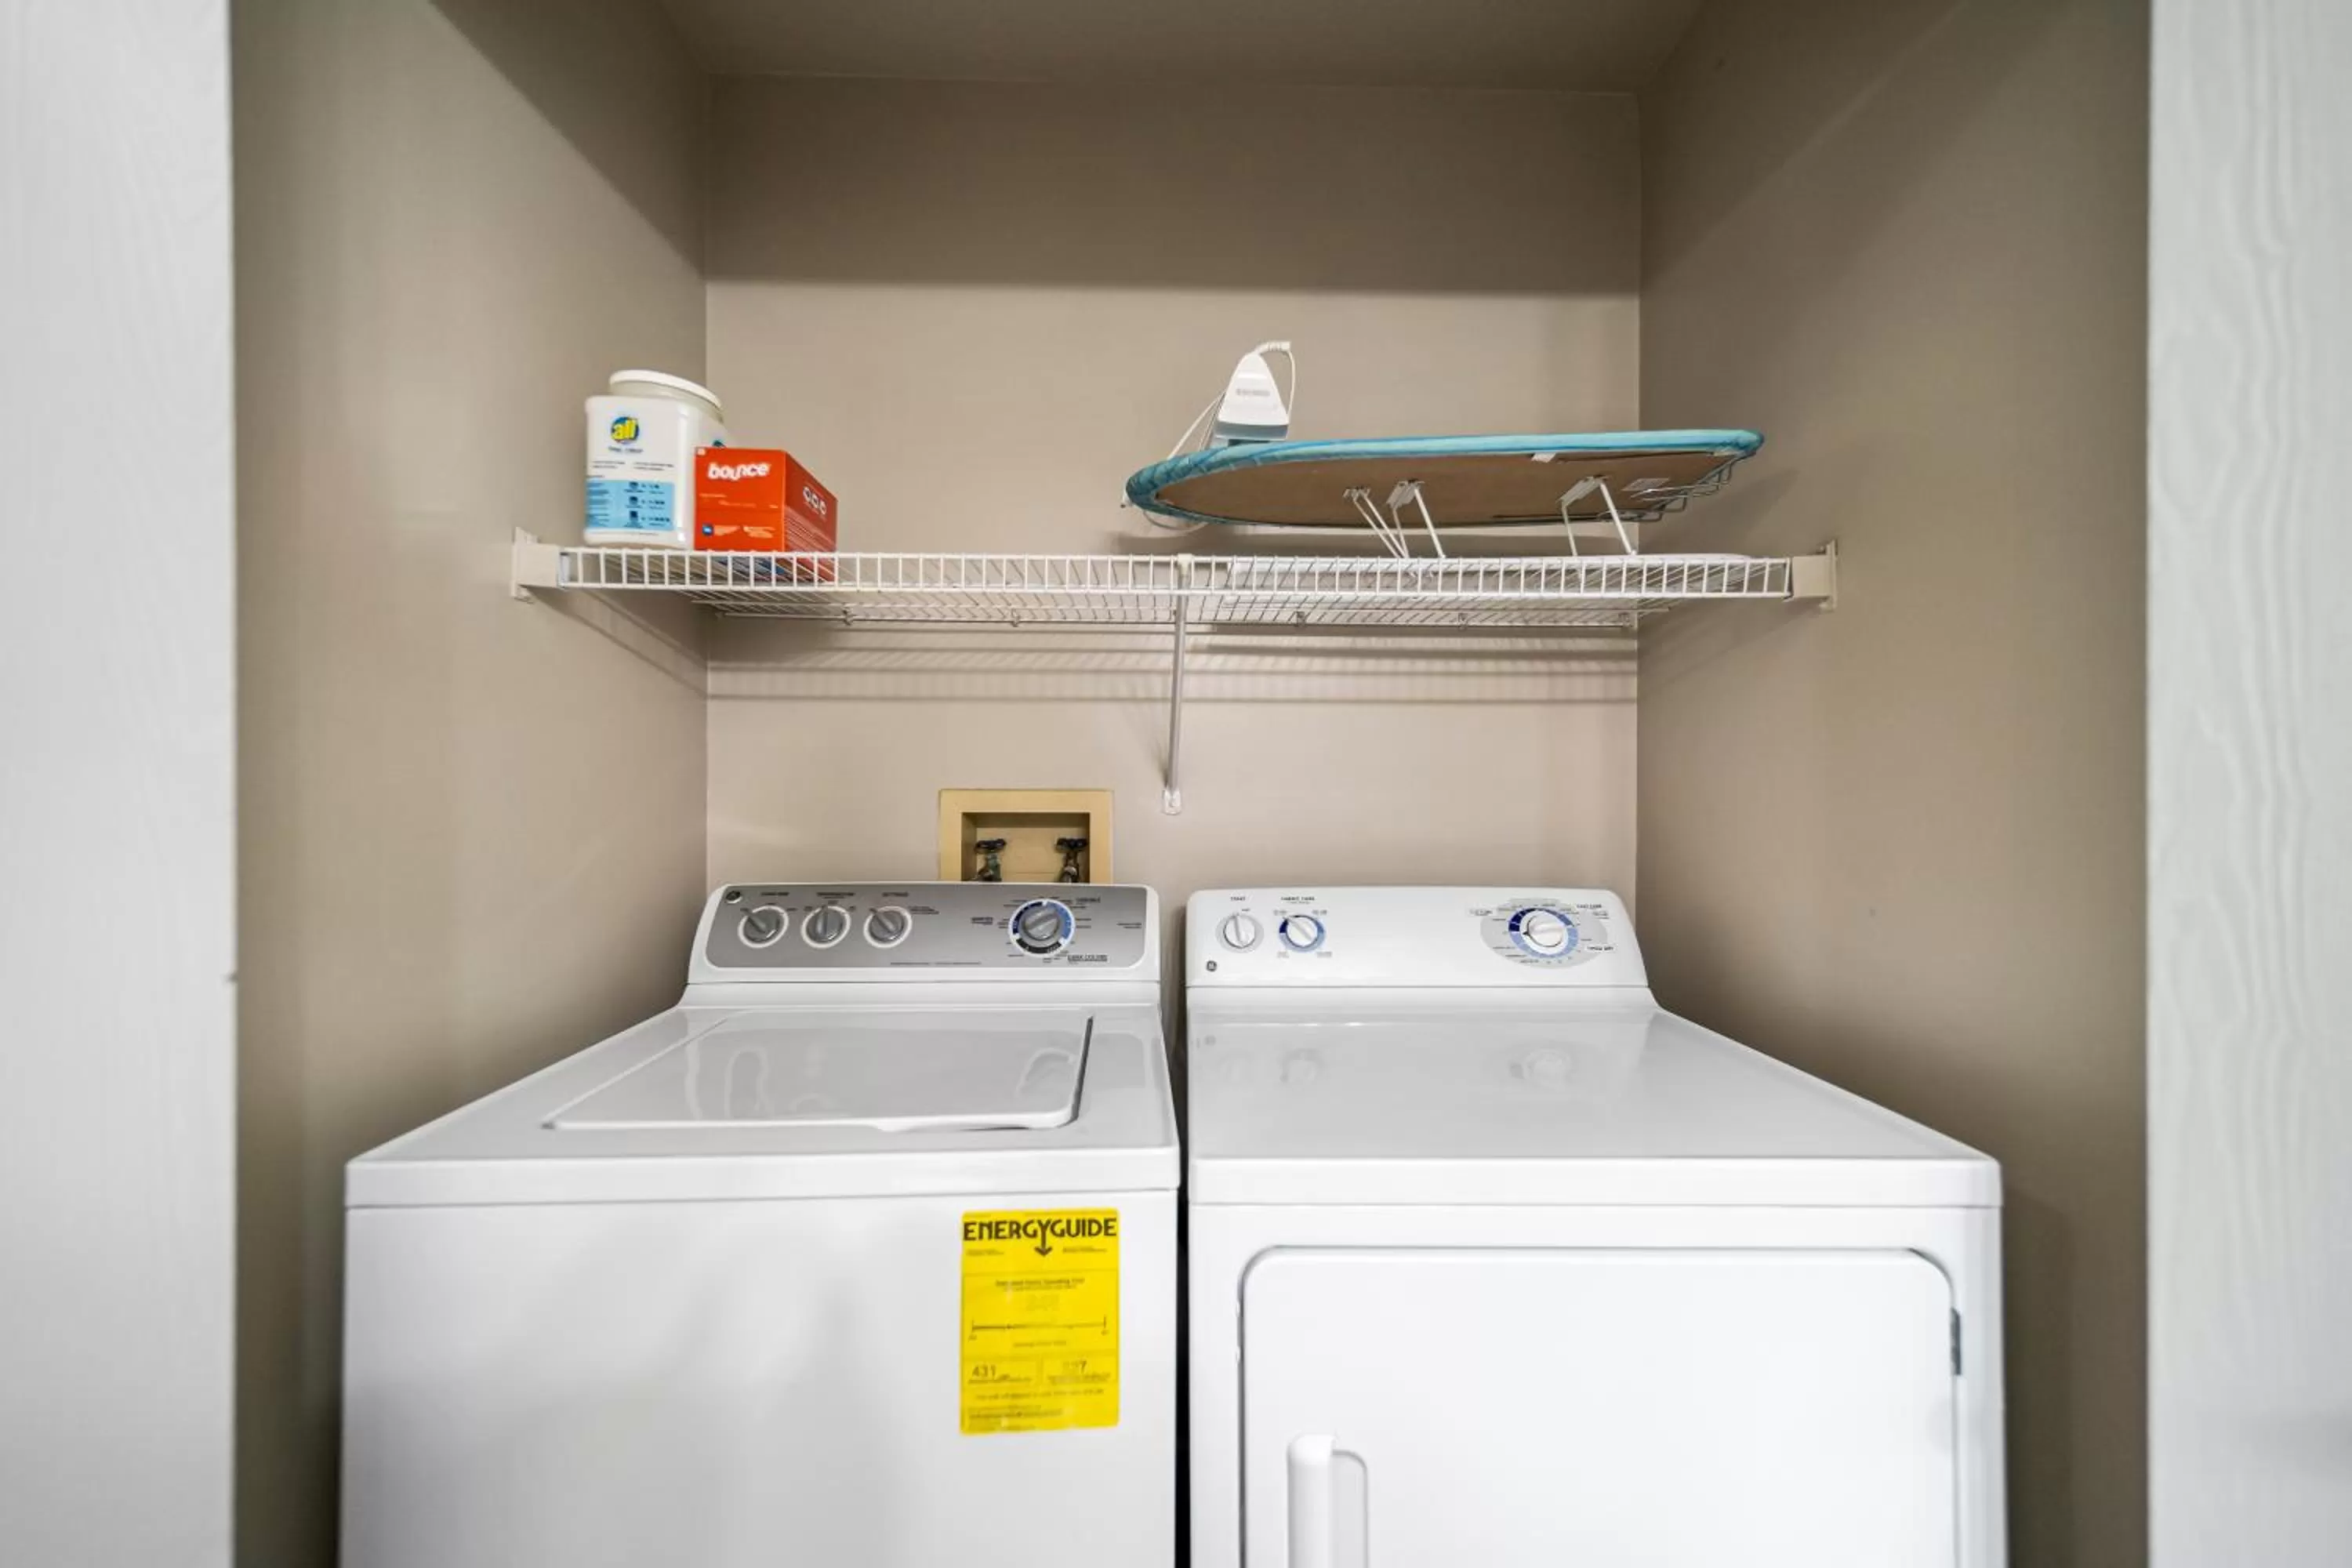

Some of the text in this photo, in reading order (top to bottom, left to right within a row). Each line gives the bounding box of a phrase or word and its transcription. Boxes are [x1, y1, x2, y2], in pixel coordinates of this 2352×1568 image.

[611, 417, 638, 441] all
[708, 462, 771, 481] bounce
[963, 1218, 1117, 1242] ENERGYGUIDE
